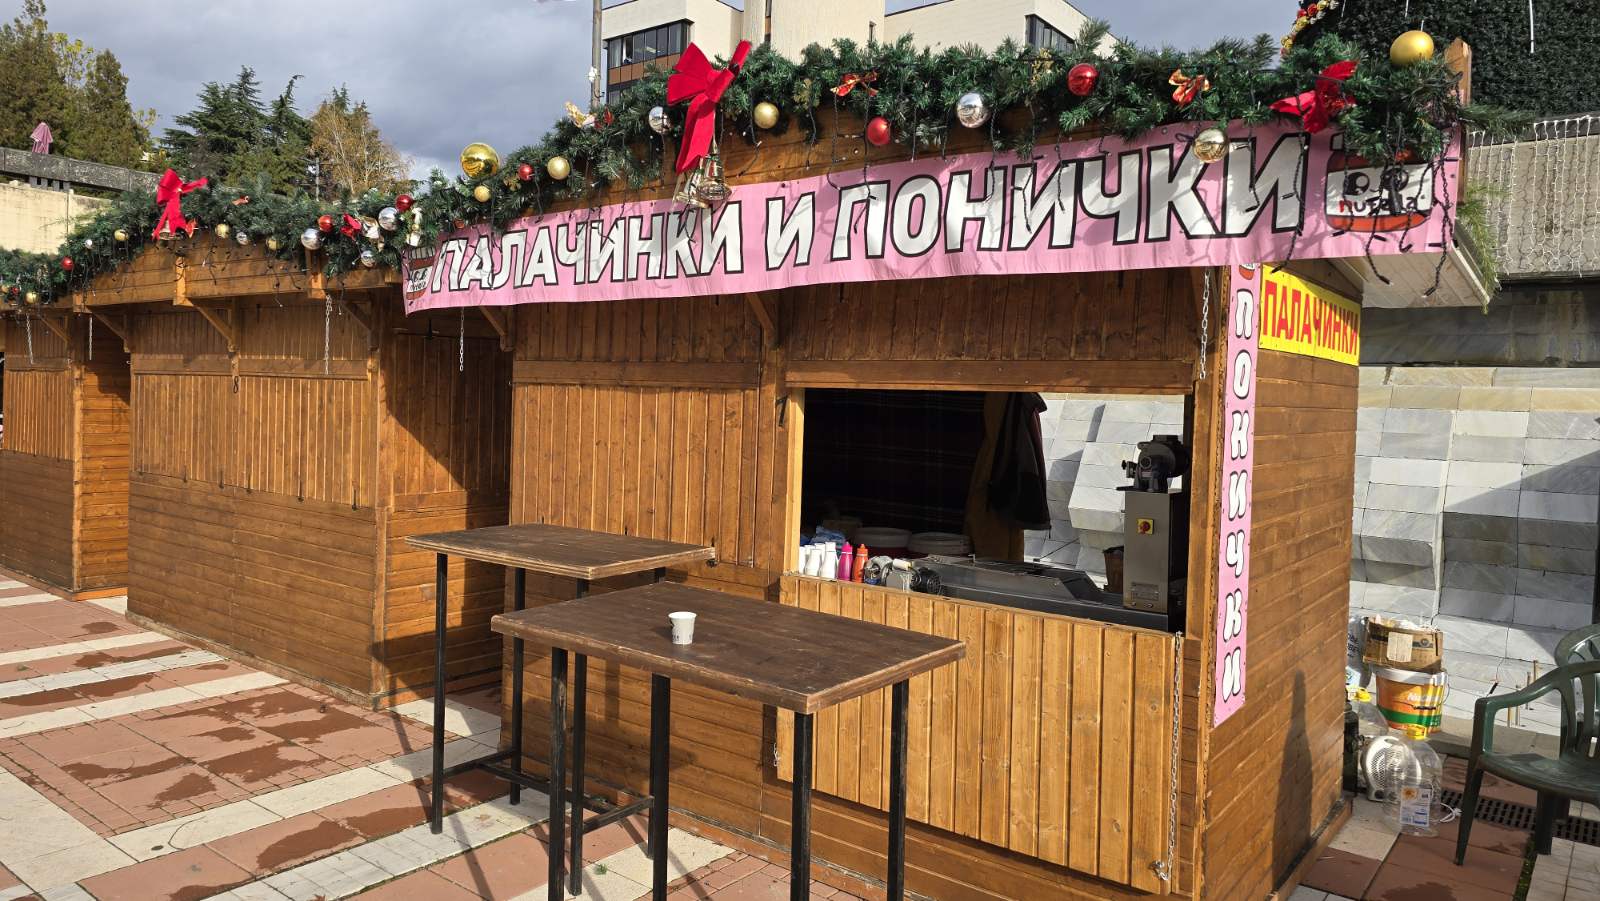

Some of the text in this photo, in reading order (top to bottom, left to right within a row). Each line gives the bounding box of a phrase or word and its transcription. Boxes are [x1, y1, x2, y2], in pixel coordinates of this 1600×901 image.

[431, 132, 1311, 293] ПАЛАЧИНКИ И ПОНИЧКИ
[1339, 193, 1419, 214] nutea
[1263, 280, 1359, 355] ПАЛАЧИНКИ
[1221, 288, 1254, 703] ПОНИЧКИ
